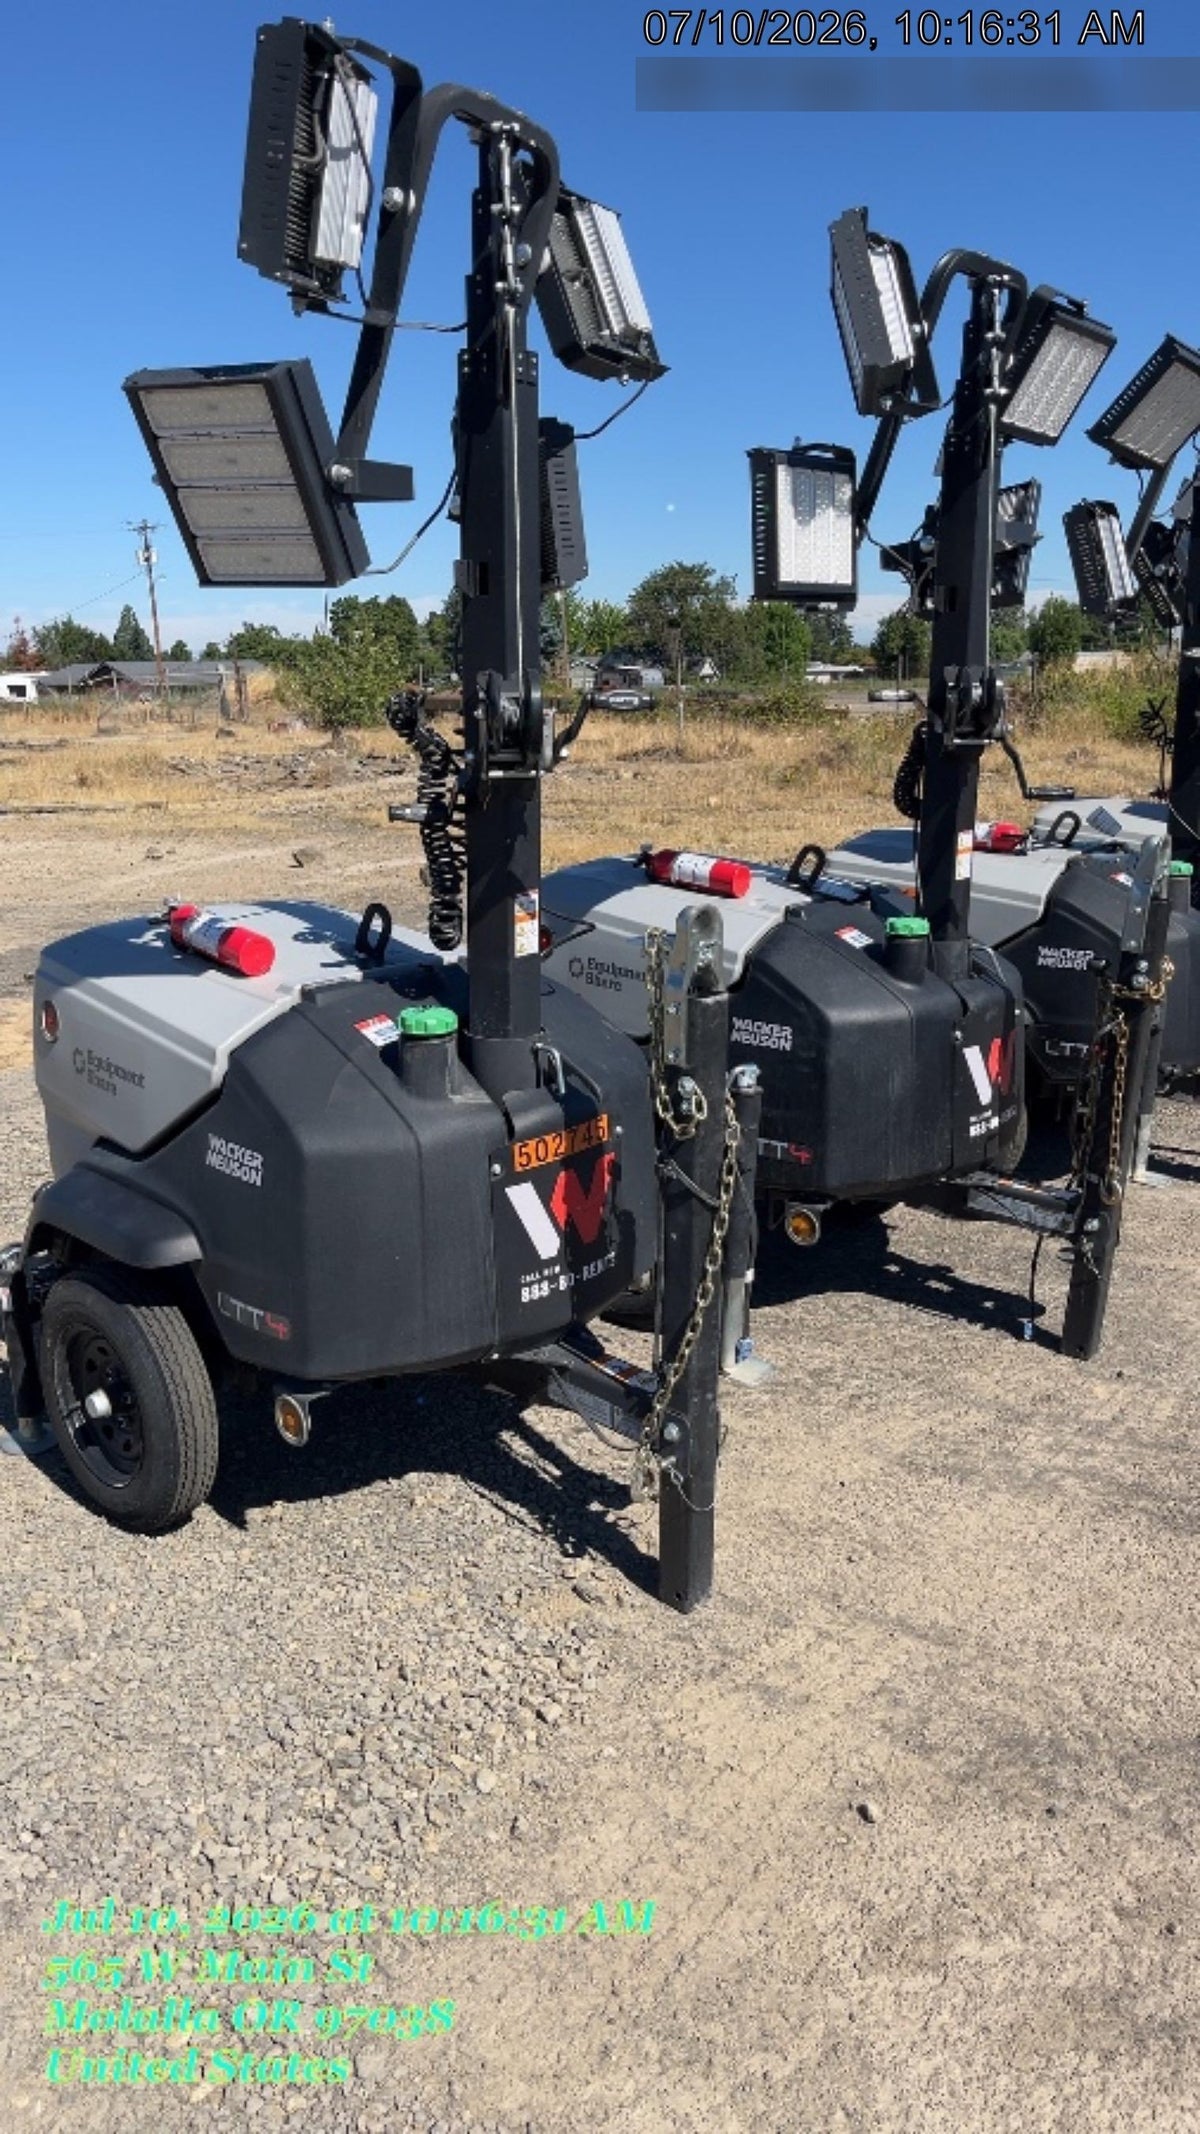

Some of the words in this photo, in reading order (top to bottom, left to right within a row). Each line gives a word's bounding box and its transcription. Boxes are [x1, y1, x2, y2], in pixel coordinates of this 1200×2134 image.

[1038, 945, 1095, 961] WACKER
[730, 1031, 793, 1051] NEUSON
[732, 1016, 793, 1040] WACKER
[208, 1133, 264, 1169] WACKER
[757, 1138, 811, 1166] TT4
[205, 1150, 263, 1186] NEUSON
